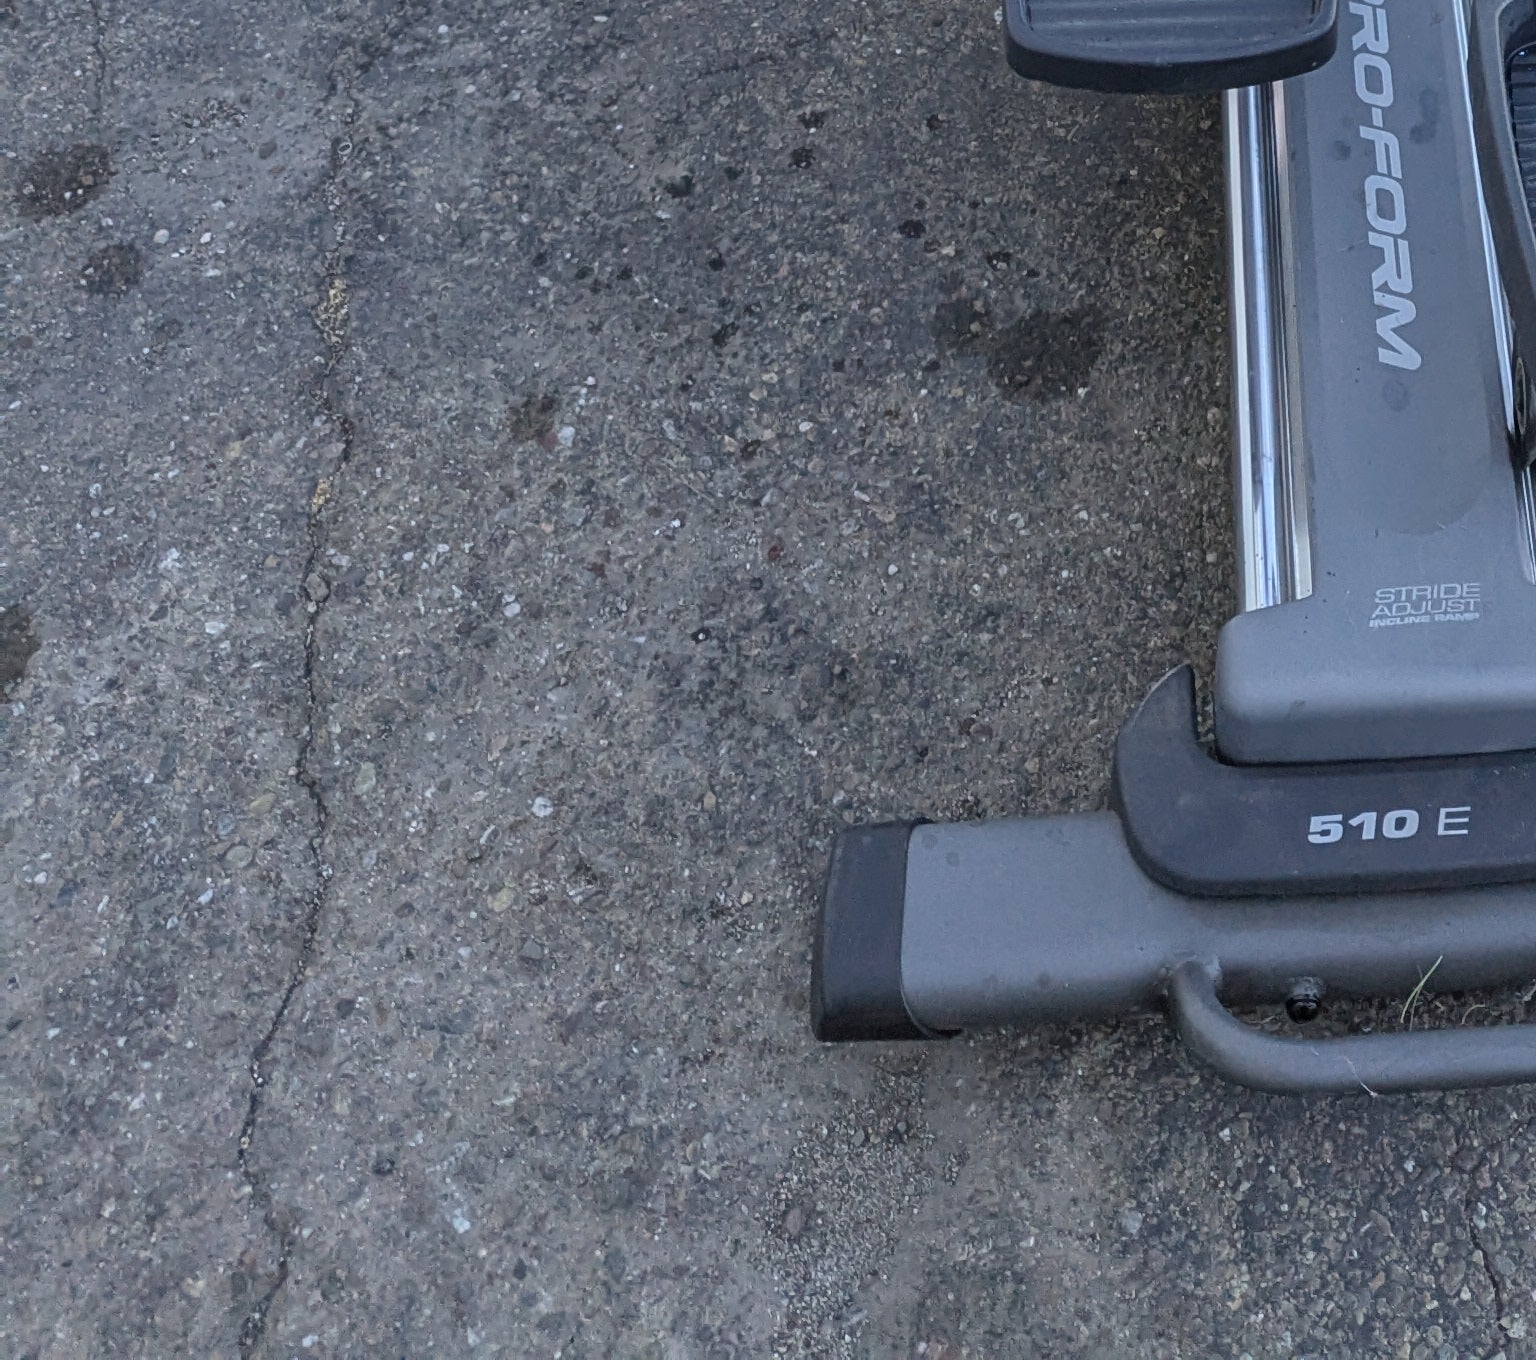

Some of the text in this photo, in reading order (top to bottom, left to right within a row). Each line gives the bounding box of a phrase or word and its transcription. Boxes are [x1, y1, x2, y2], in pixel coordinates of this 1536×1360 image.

[1374, 583, 1481, 604] STRIDE
[1371, 598, 1481, 618] ADJUST
[1369, 611, 1480, 628] INCLINE RAMP
[1307, 805, 1472, 844] 510 E
